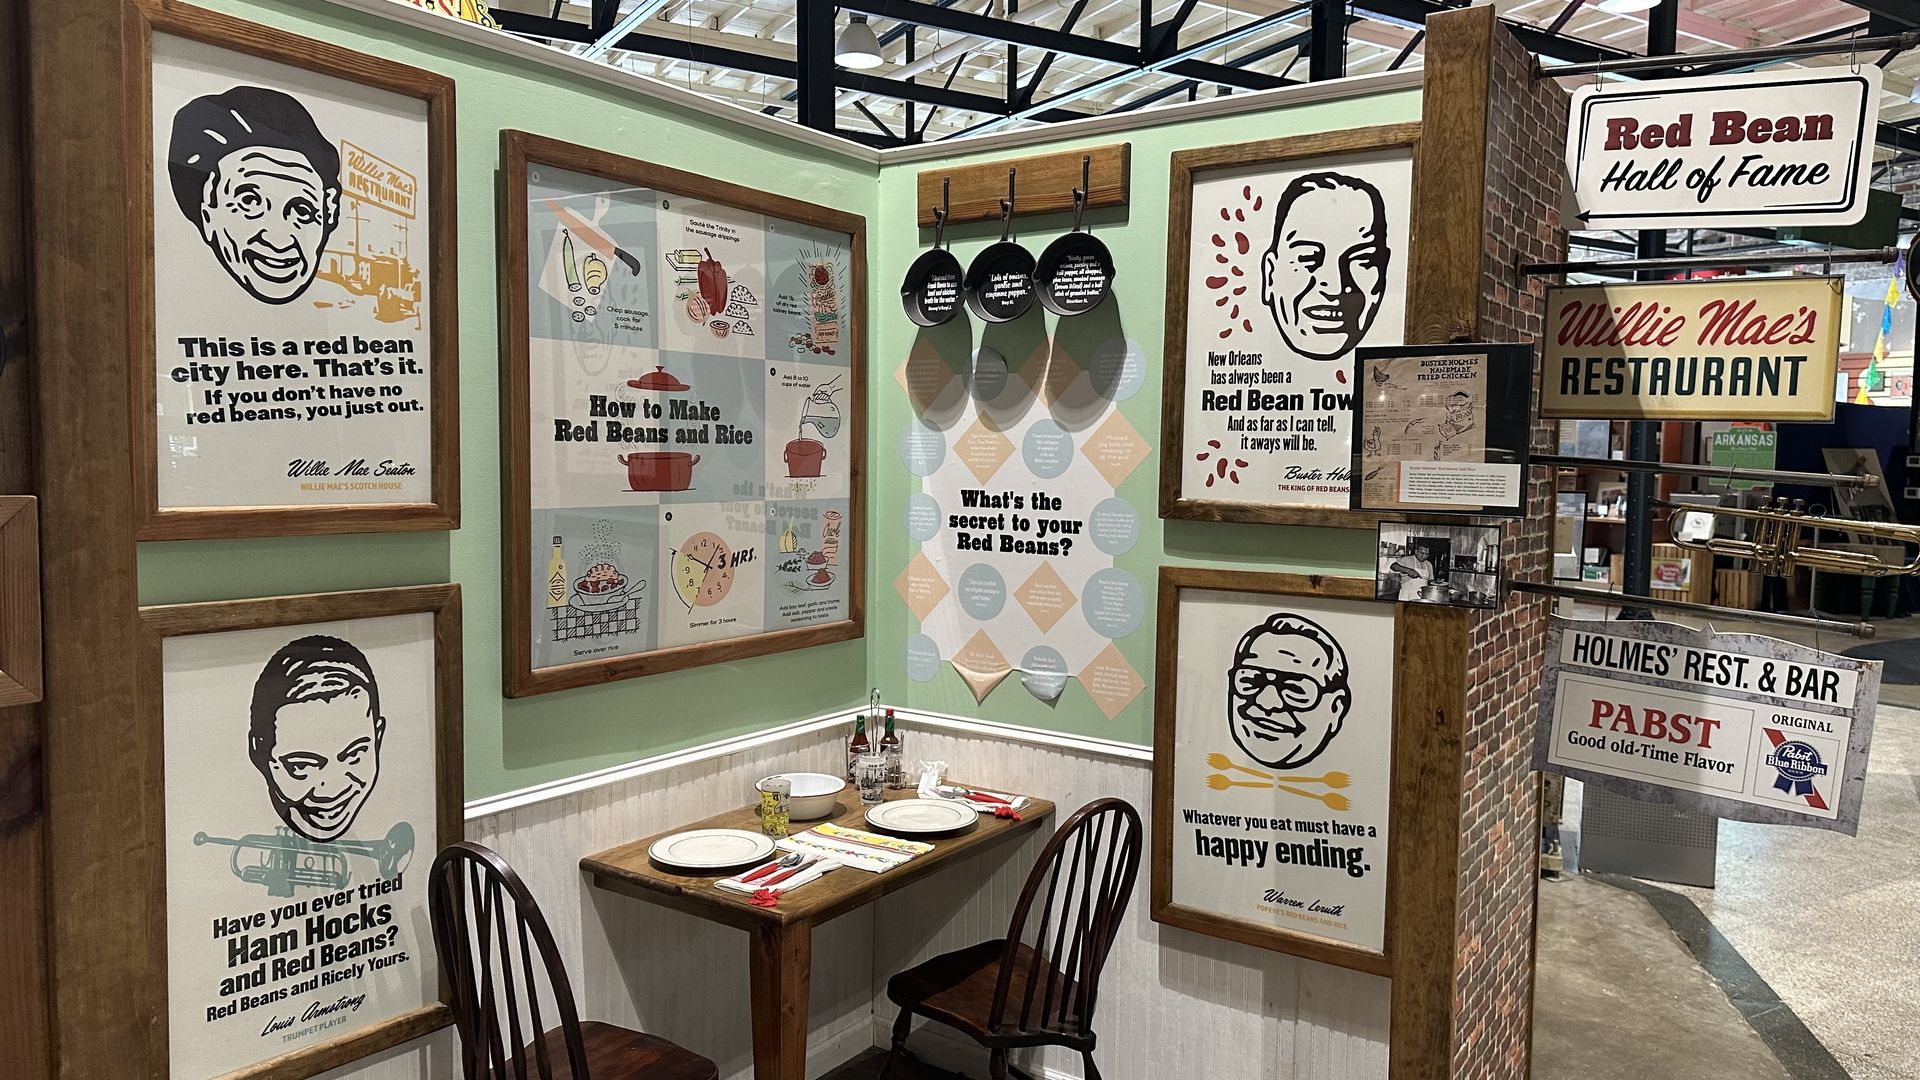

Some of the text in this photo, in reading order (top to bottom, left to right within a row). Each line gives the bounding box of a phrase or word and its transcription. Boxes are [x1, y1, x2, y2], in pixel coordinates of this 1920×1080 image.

[1604, 111, 1833, 150] Red Bean
[1600, 154, 1829, 203] Hall of Fame
[607, 306, 623, 314] Chop
[1558, 299, 1817, 347] Willie Mae's
[178, 336, 413, 357] This is a red bean
[1208, 351, 1262, 366] New Orleans
[171, 358, 423, 386] city here. That's it.
[1449, 358, 1478, 366] HOLMES
[1211, 369, 1291, 387] has always been a
[1560, 356, 1807, 396] RESTAURANT
[205, 385, 402, 407] If you don't have no
[590, 395, 720, 421] How to Make
[1202, 389, 1354, 411] Red Bean Tow
[187, 399, 423, 424] red beans, you just out.
[555, 419, 752, 445] Red Beans and Rice
[1227, 416, 1336, 433] And as far as I can tell,
[1241, 434, 1317, 454] it aways will be.
[1715, 434, 1773, 446] ARKANSAS
[287, 459, 415, 477] Willie Mae Seaton
[1284, 466, 1322, 480] Buster
[300, 483, 326, 491] WILLIE
[378, 482, 402, 490] HOUSE
[961, 489, 1062, 511] What's the
[949, 513, 1004, 531] secret
[1012, 513, 1030, 532] to
[1037, 519, 1082, 538] your
[957, 532, 1072, 556] Red Beans?
[718, 547, 757, 570] 3 HRS.
[690, 621, 709, 629] Simmer
[1573, 633, 1840, 703] HOLMES' REST. & BAR
[1588, 699, 1721, 749] PABST
[1772, 713, 1833, 733] ORIGINAL
[1567, 730, 1734, 775] Good old-Time Flavor
[1767, 754, 1826, 776] Blue Ribbon
[1782, 745, 1811, 761] Pabst
[1183, 809, 1377, 838] Whatever you eat must have a
[1195, 829, 1371, 878] happy ending.
[214, 872, 403, 939] Have you ever tried
[1264, 889, 1345, 917] Warren Leruth
[228, 902, 392, 968] Ham Hocks
[220, 925, 398, 996] and Red Beans?
[207, 951, 409, 1022] Red Beans and Ricely Yours.
[261, 994, 365, 1036] Louis Armstrong
[282, 1015, 347, 1043] TRUMPET PLAYER
